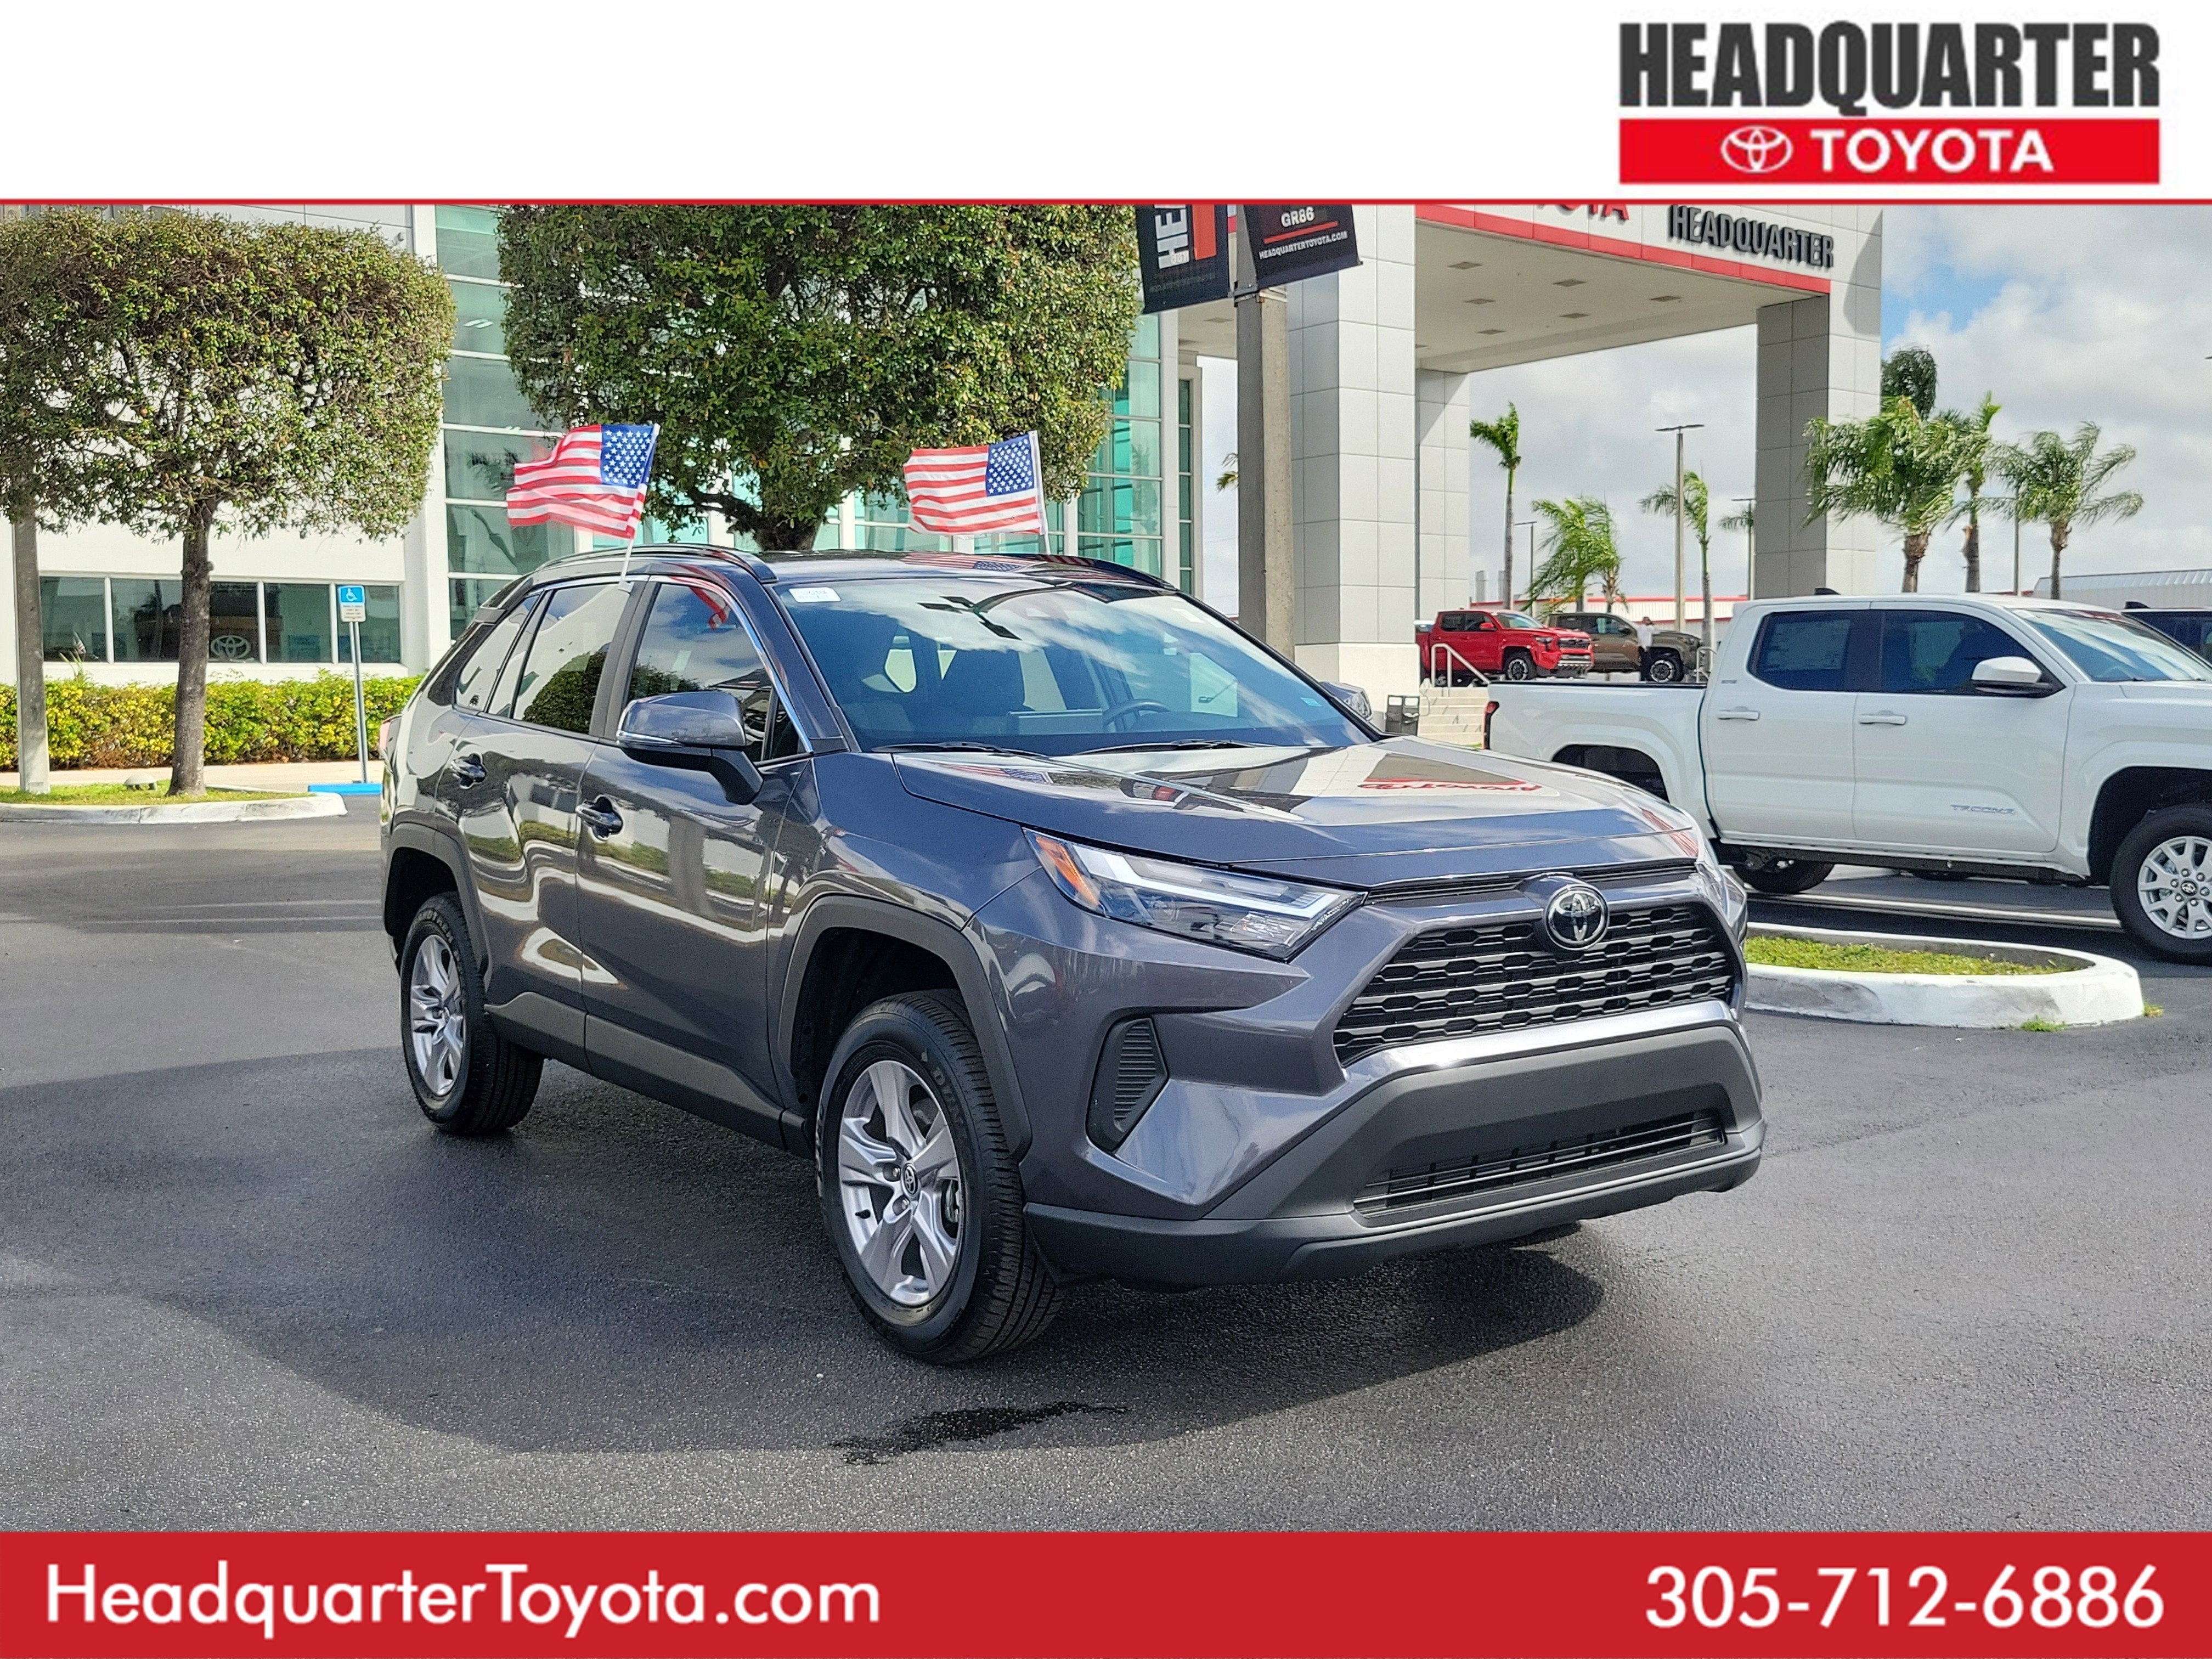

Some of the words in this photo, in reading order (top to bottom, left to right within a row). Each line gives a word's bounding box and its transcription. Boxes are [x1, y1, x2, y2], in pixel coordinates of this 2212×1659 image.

[1280, 206, 1315, 228] GR86
[1259, 230, 1348, 260] HEADQUARTERTOYOTA.COM
[1671, 205, 1833, 268] HEADQUARTER
